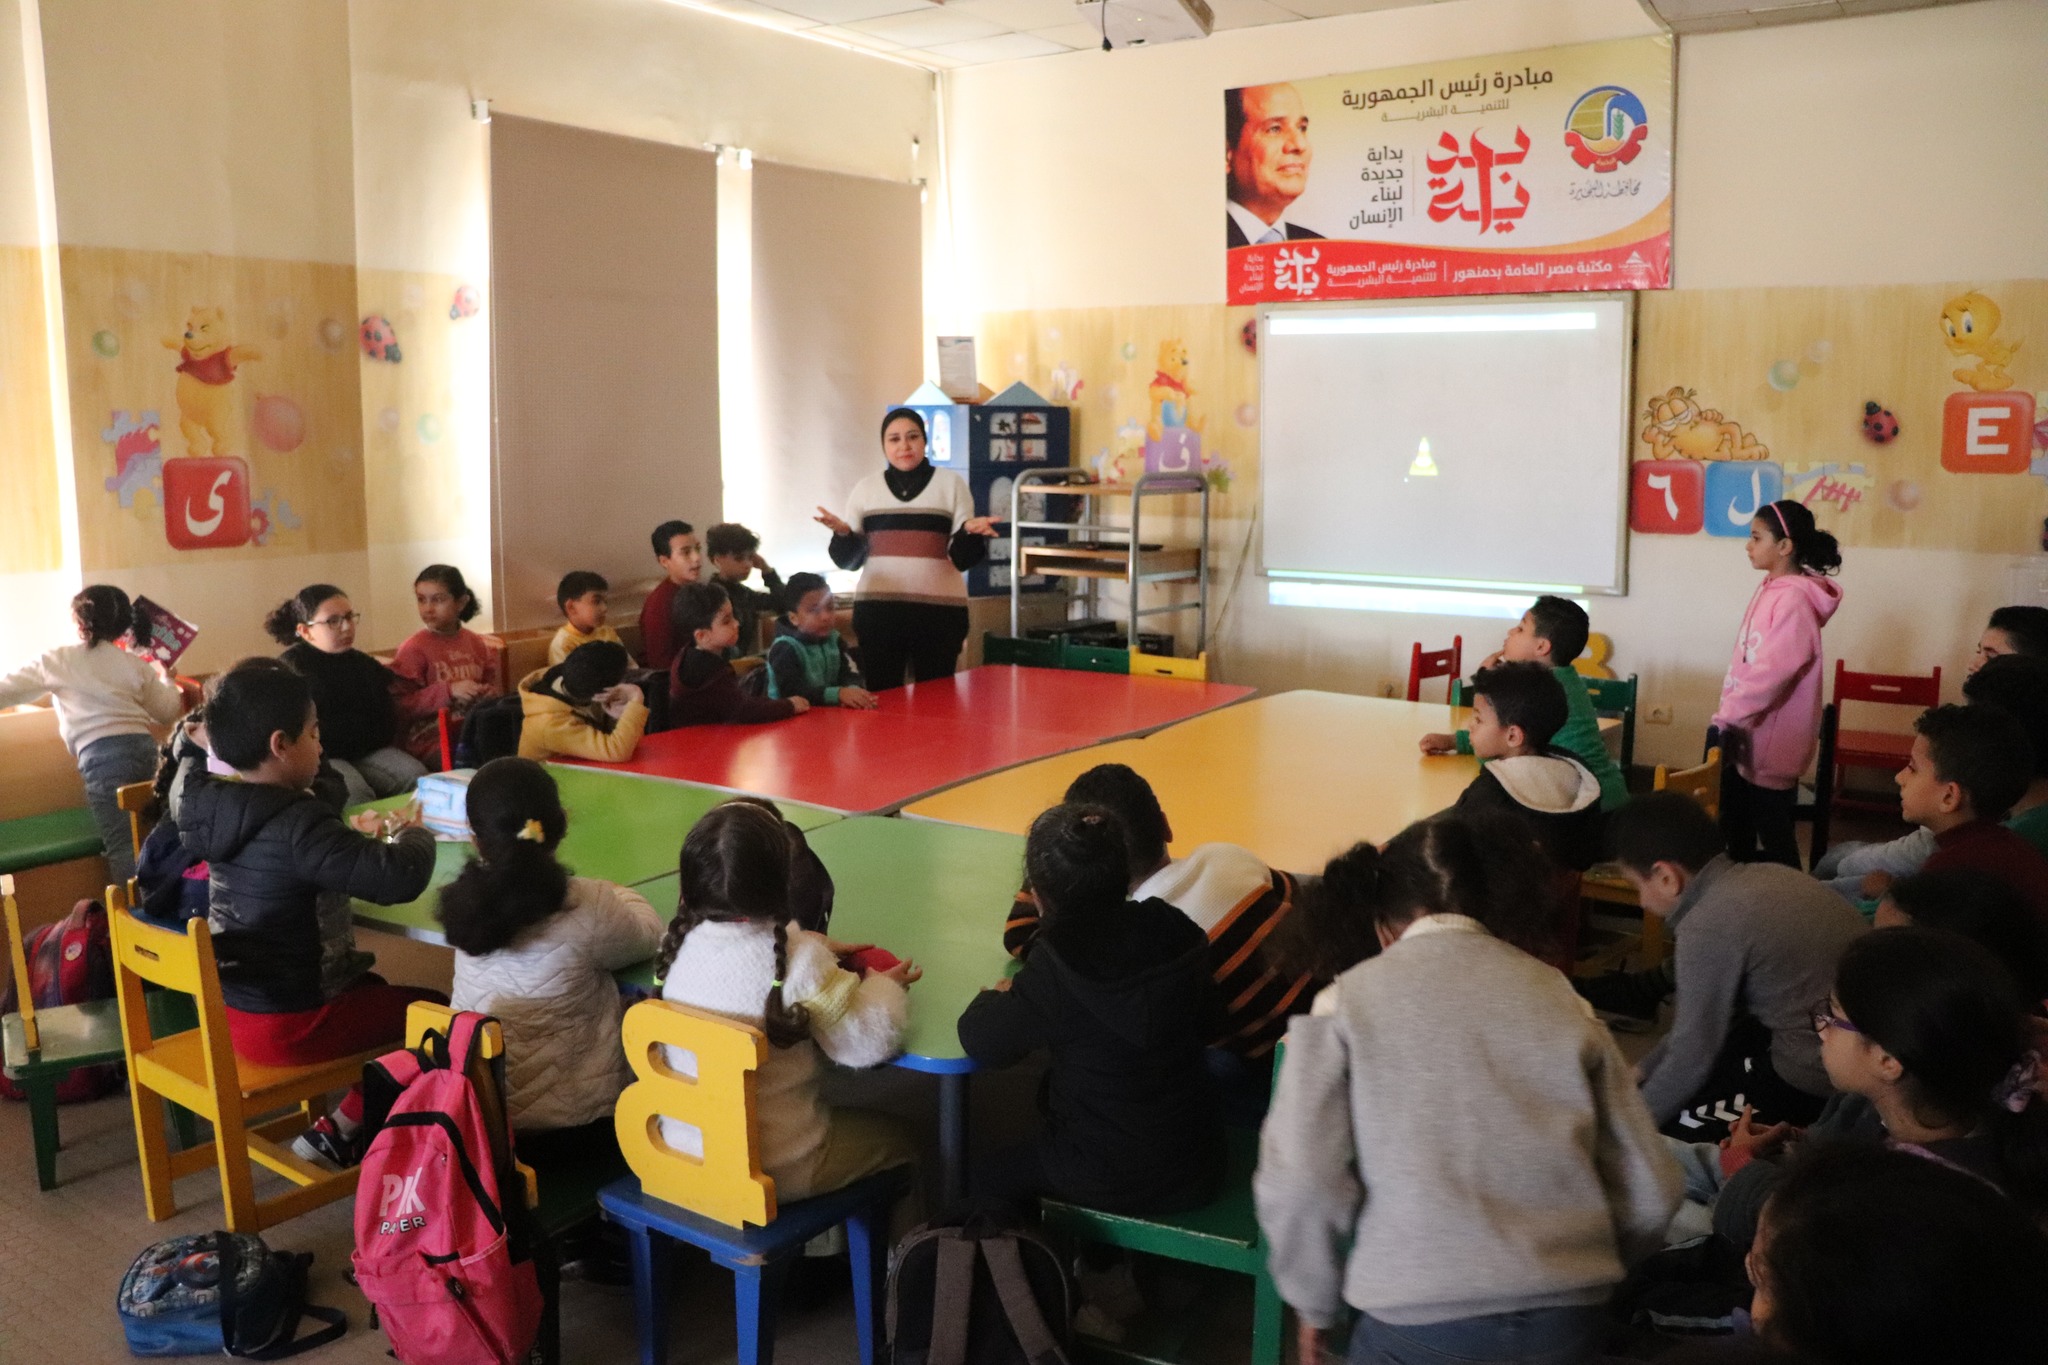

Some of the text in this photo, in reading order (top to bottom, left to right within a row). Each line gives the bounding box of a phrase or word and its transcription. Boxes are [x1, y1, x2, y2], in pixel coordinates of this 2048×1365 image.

[1342, 67, 1553, 110] مبادرة رئيس الجمهورية
[1367, 146, 1403, 165] بداية
[1361, 167, 1404, 184] جديدة
[1371, 185, 1403, 205] لبناء
[1349, 207, 1403, 230] الإنسان
[1326, 258, 1436, 277] مبادرة رئيس الجمهورية
[1452, 265, 1502, 283] بدمنهور
[1504, 262, 1545, 277] العامة
[1546, 263, 1574, 279] مصر
[1577, 260, 1613, 277] مكتبة
[1966, 407, 2010, 456] E
[1728, 467, 1761, 526] ل
